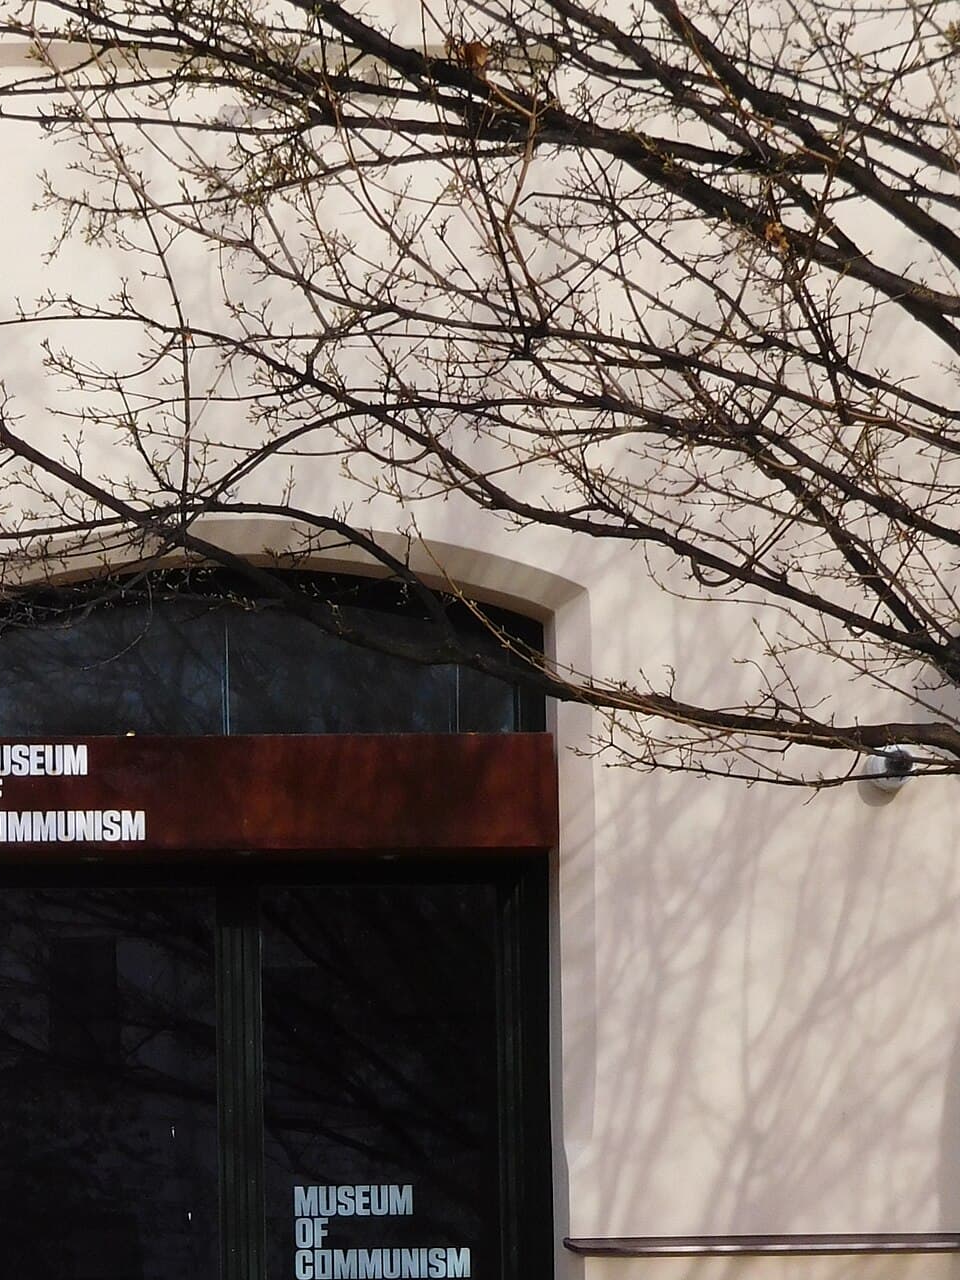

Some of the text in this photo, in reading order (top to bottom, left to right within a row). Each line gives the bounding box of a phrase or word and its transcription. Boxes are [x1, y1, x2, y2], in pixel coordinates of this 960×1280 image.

[294, 1184, 413, 1216] MUSEUM
[295, 1217, 329, 1248] OF
[295, 1247, 471, 1280] COMMUNISM
